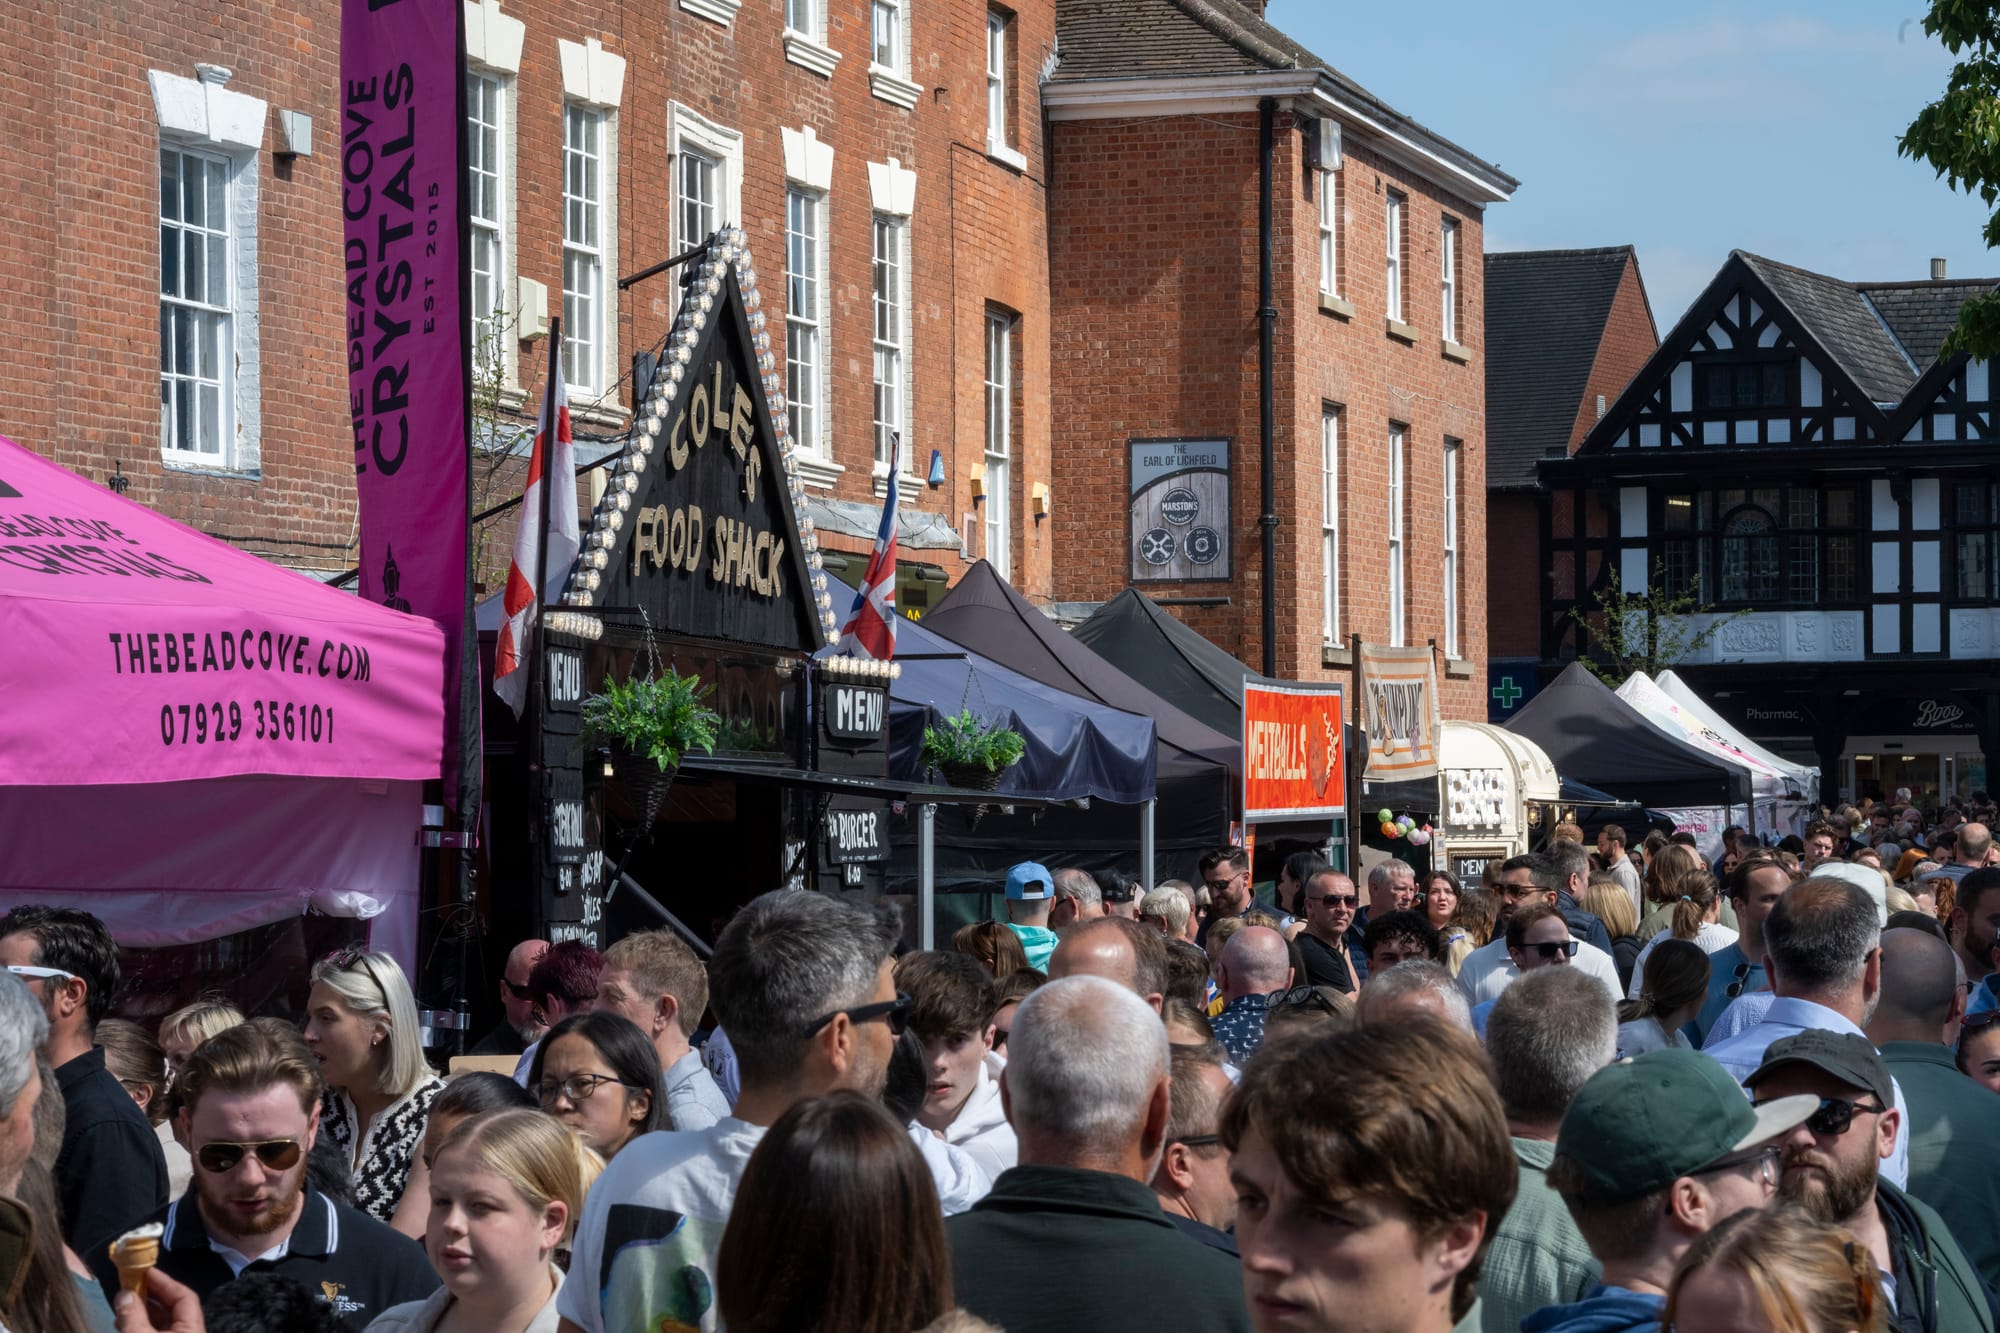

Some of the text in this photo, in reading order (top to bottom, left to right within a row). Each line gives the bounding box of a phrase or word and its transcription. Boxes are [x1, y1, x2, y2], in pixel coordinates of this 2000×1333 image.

[343, 76, 378, 222] COVE
[372, 62, 415, 476] CRYSTALS
[423, 182, 440, 335] EST 2015
[1143, 454, 1217, 467] EARL OF LICHFIELD
[1173, 444, 1187, 454] THE
[0, 544, 214, 585] CRYSTALS
[634, 503, 785, 599] FOOD SHACK
[108, 629, 371, 682] THEBEADCOVE.COM
[550, 652, 580, 701] MENU
[160, 700, 334, 746] 07929 356101
[837, 688, 883, 732] MENU
[1247, 720, 1307, 780] MEATBALLS
[838, 812, 878, 851] BURGER
[1460, 858, 1489, 876] MEN
